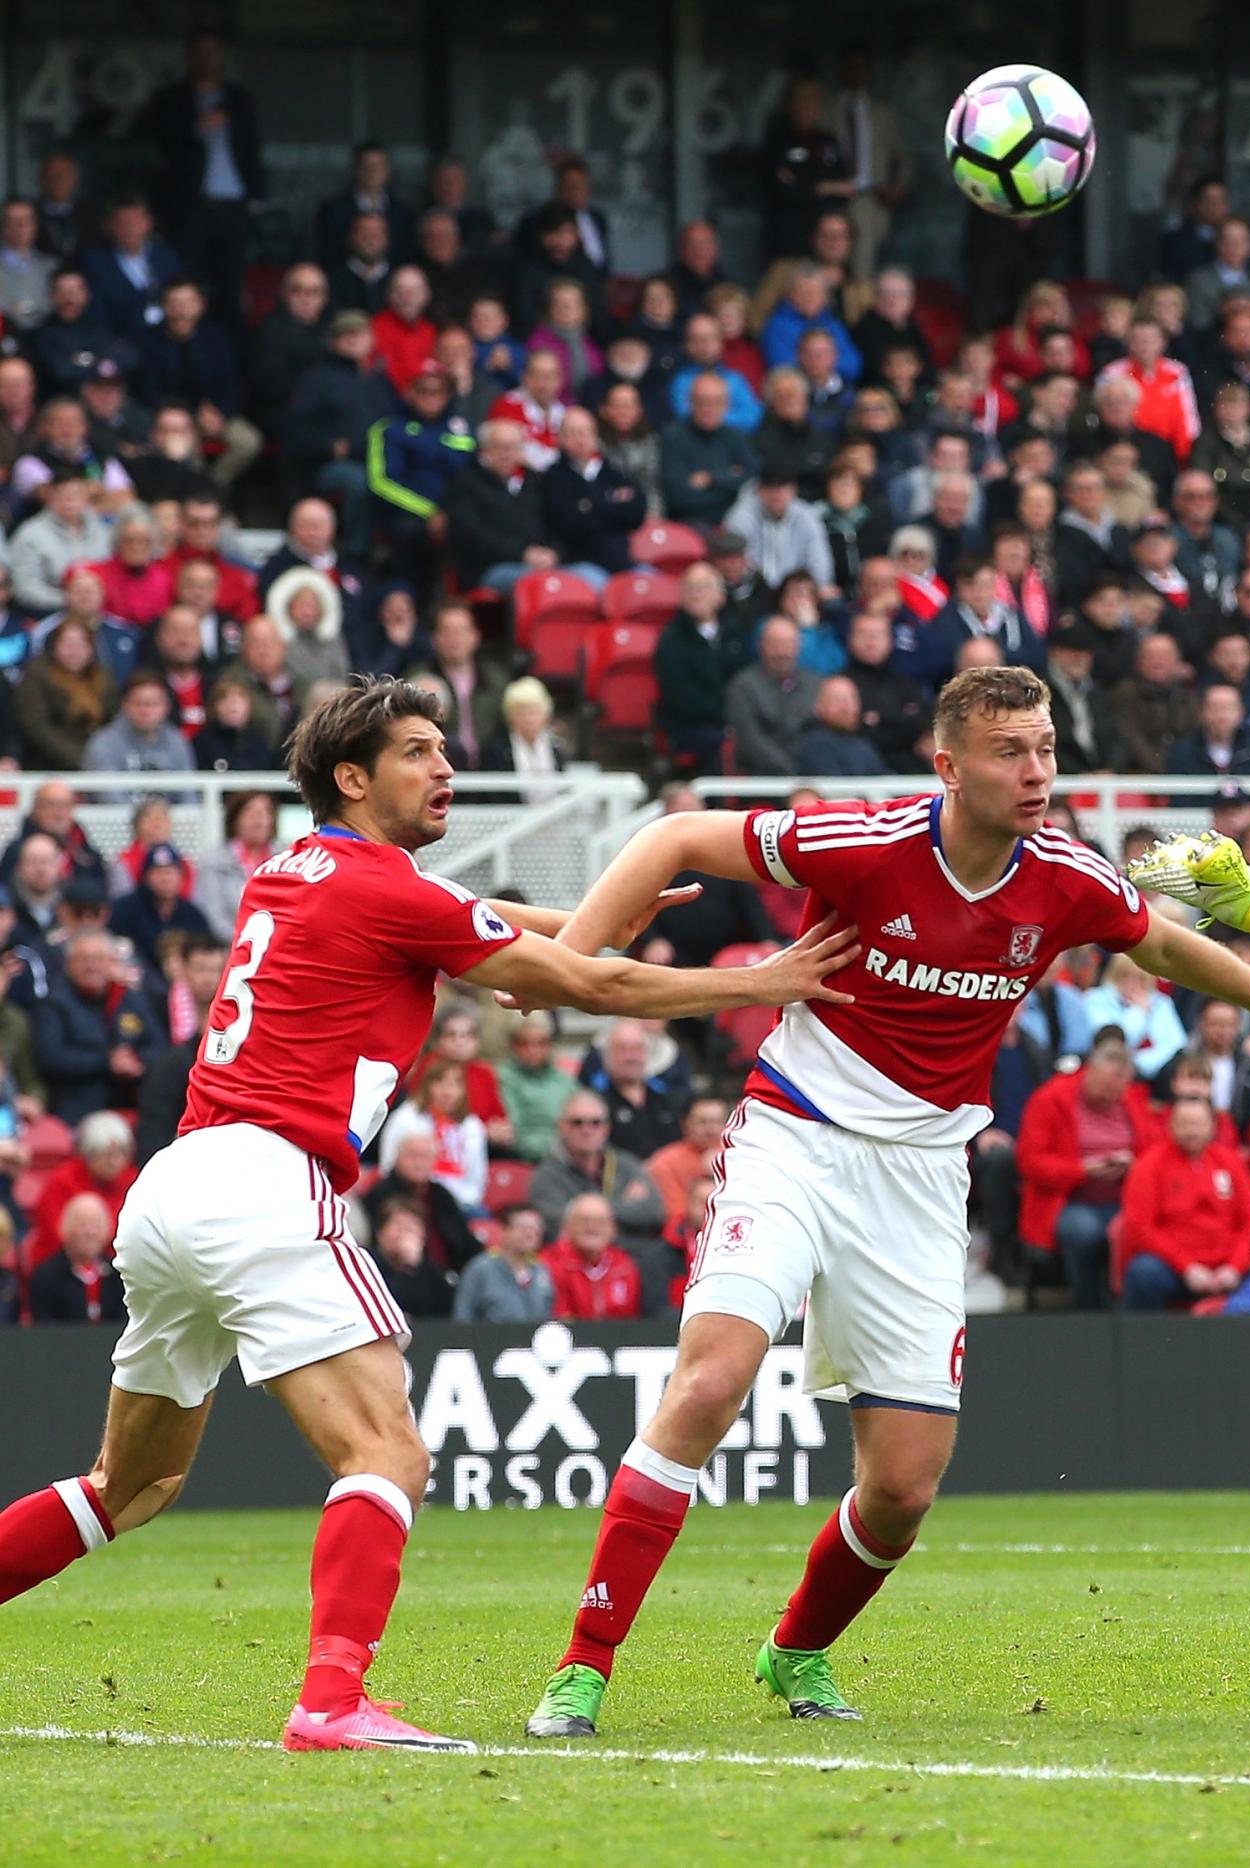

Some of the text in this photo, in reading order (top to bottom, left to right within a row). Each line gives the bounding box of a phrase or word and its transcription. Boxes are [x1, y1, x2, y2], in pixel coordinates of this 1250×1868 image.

[881, 925, 917, 940] adidas
[203, 909, 275, 1065] 3
[865, 947, 1030, 1001] RAMSDENS
